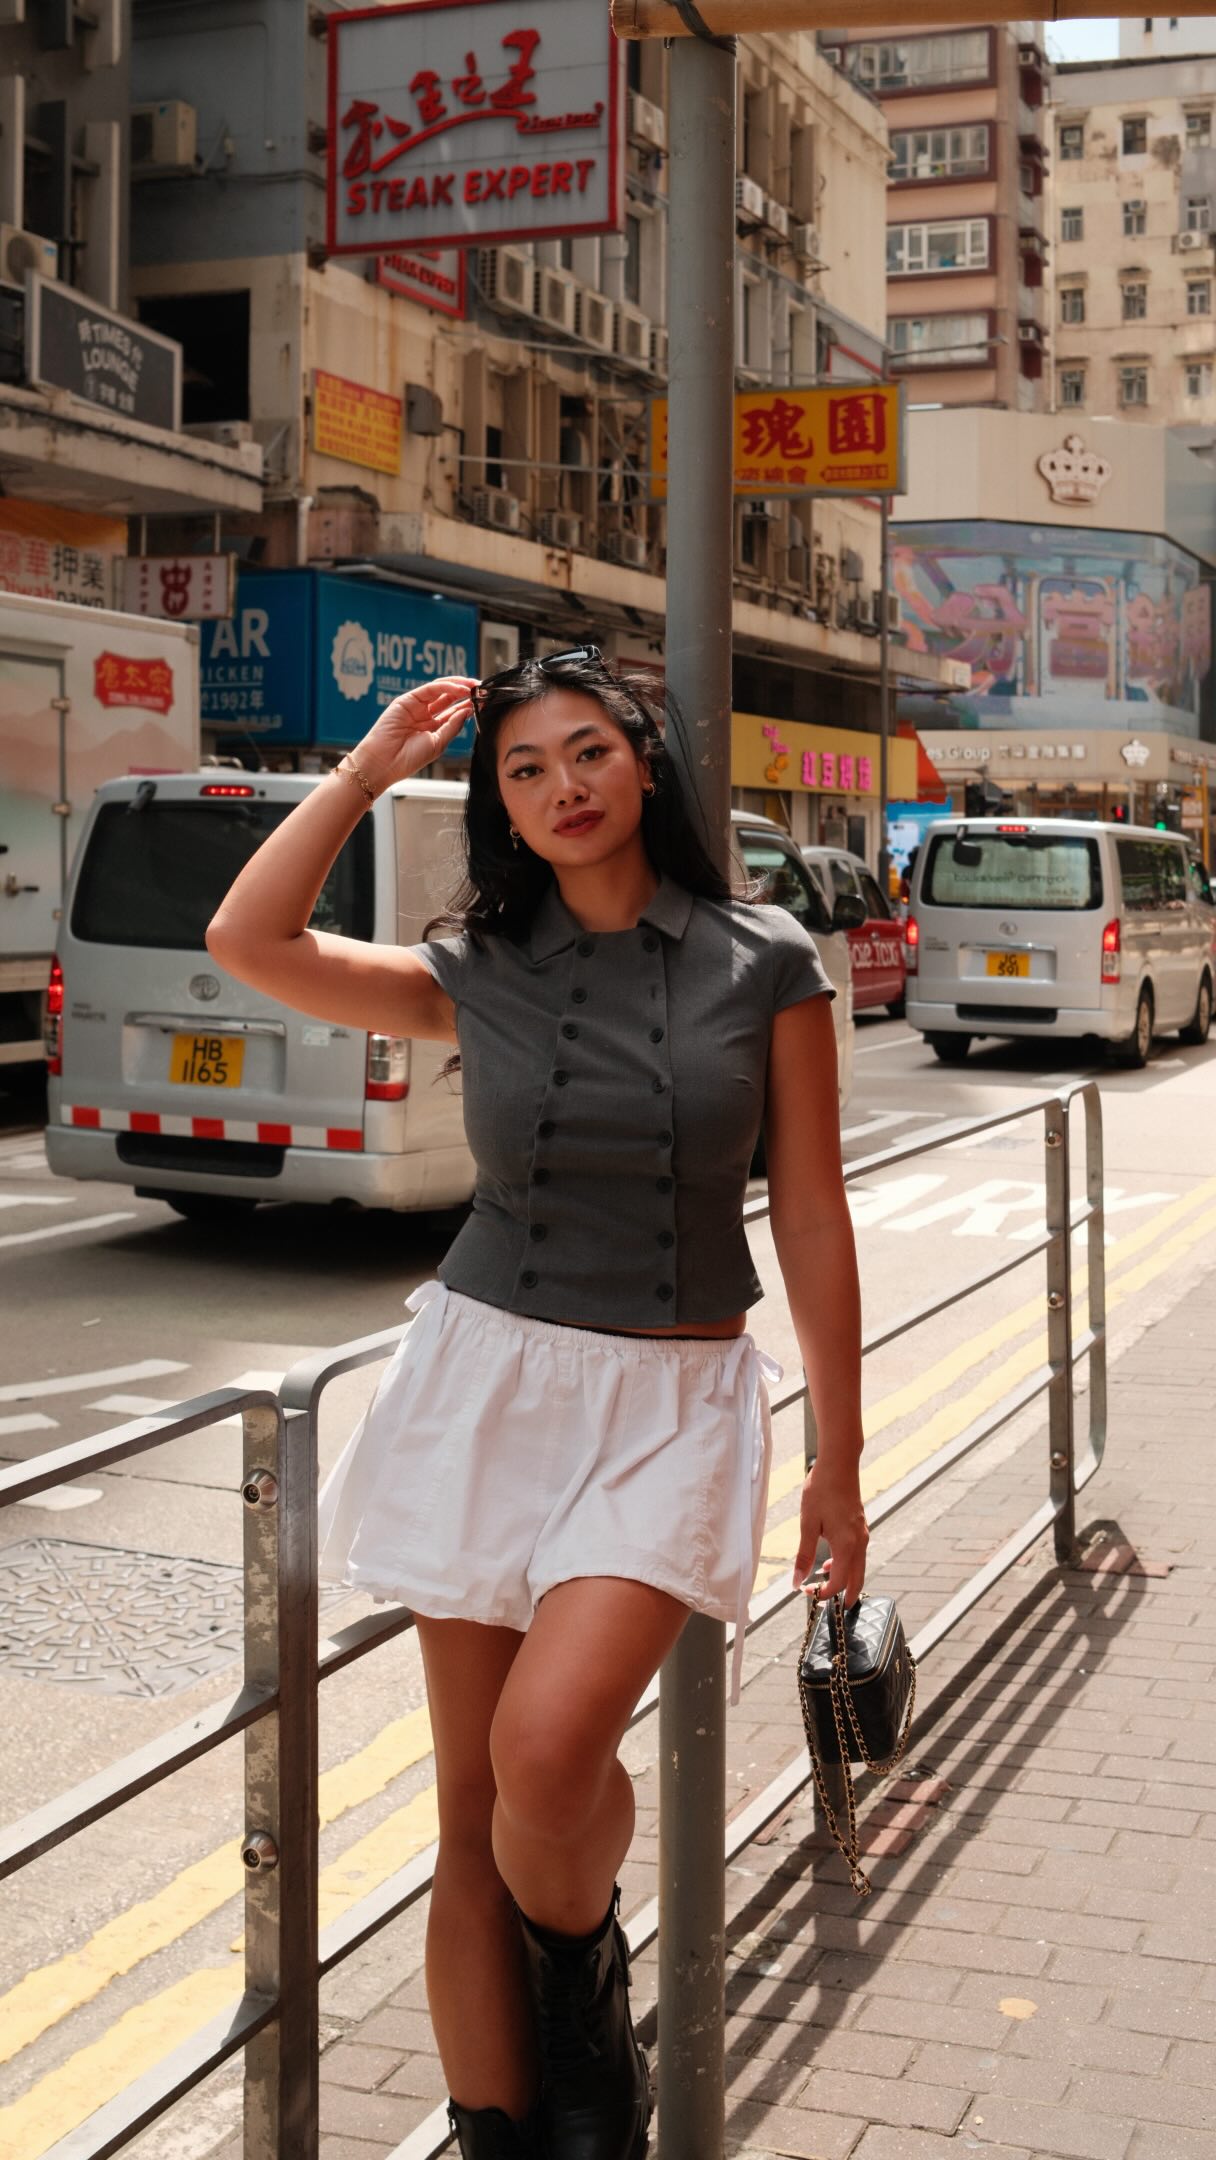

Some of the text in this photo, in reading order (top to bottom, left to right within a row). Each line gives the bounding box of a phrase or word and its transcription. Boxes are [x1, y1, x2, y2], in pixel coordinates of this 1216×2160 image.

[346, 160, 595, 216] STEAK EXPERT
[82, 347, 139, 393] LOUNGE
[377, 632, 468, 677] HOT-STAR
[948, 745, 991, 762] Group
[192, 1037, 223, 1062] HB
[182, 1060, 229, 1084] 1165
